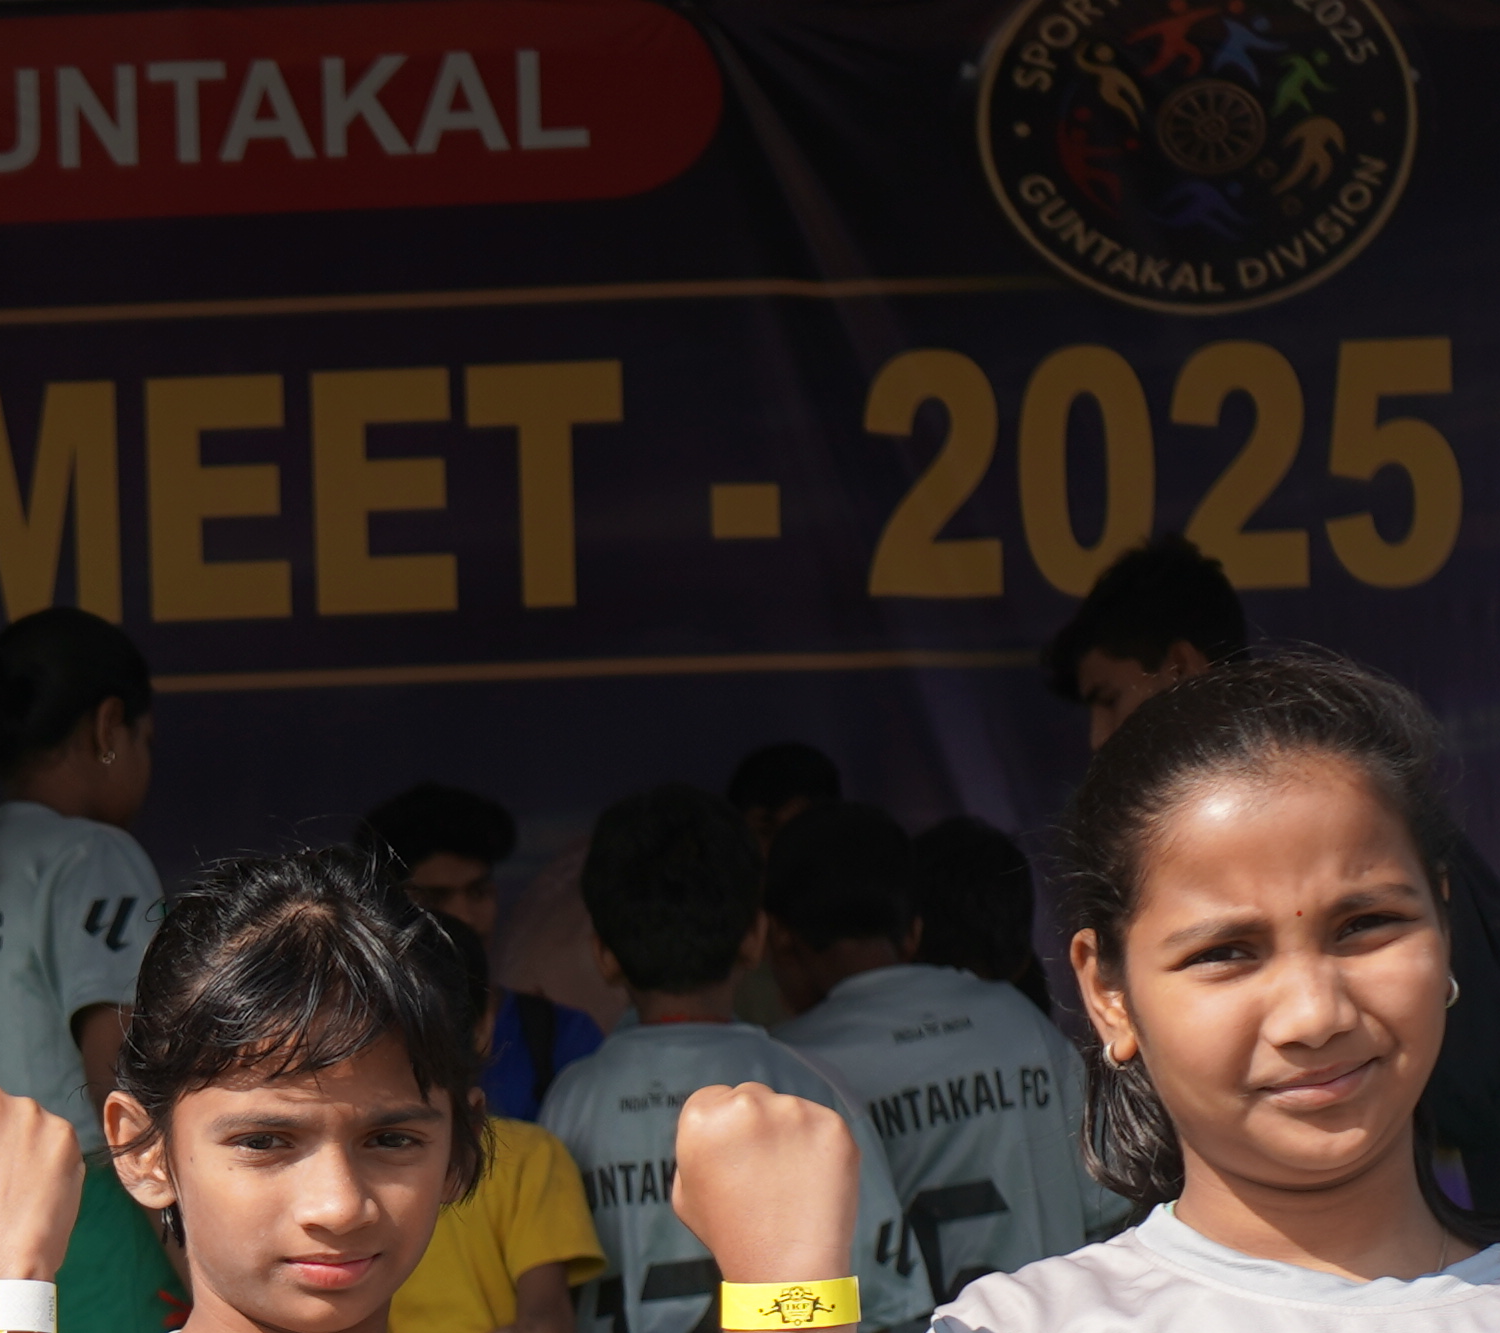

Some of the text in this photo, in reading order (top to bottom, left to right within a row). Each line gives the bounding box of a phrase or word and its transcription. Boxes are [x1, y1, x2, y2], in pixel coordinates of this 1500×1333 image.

[1012, 0, 1106, 93] SPOR
[1018, 152, 1388, 293] GUNTAKAL DIVISION
[864, 336, 1464, 600] 2025
[1021, 1068, 1050, 1109] FC
